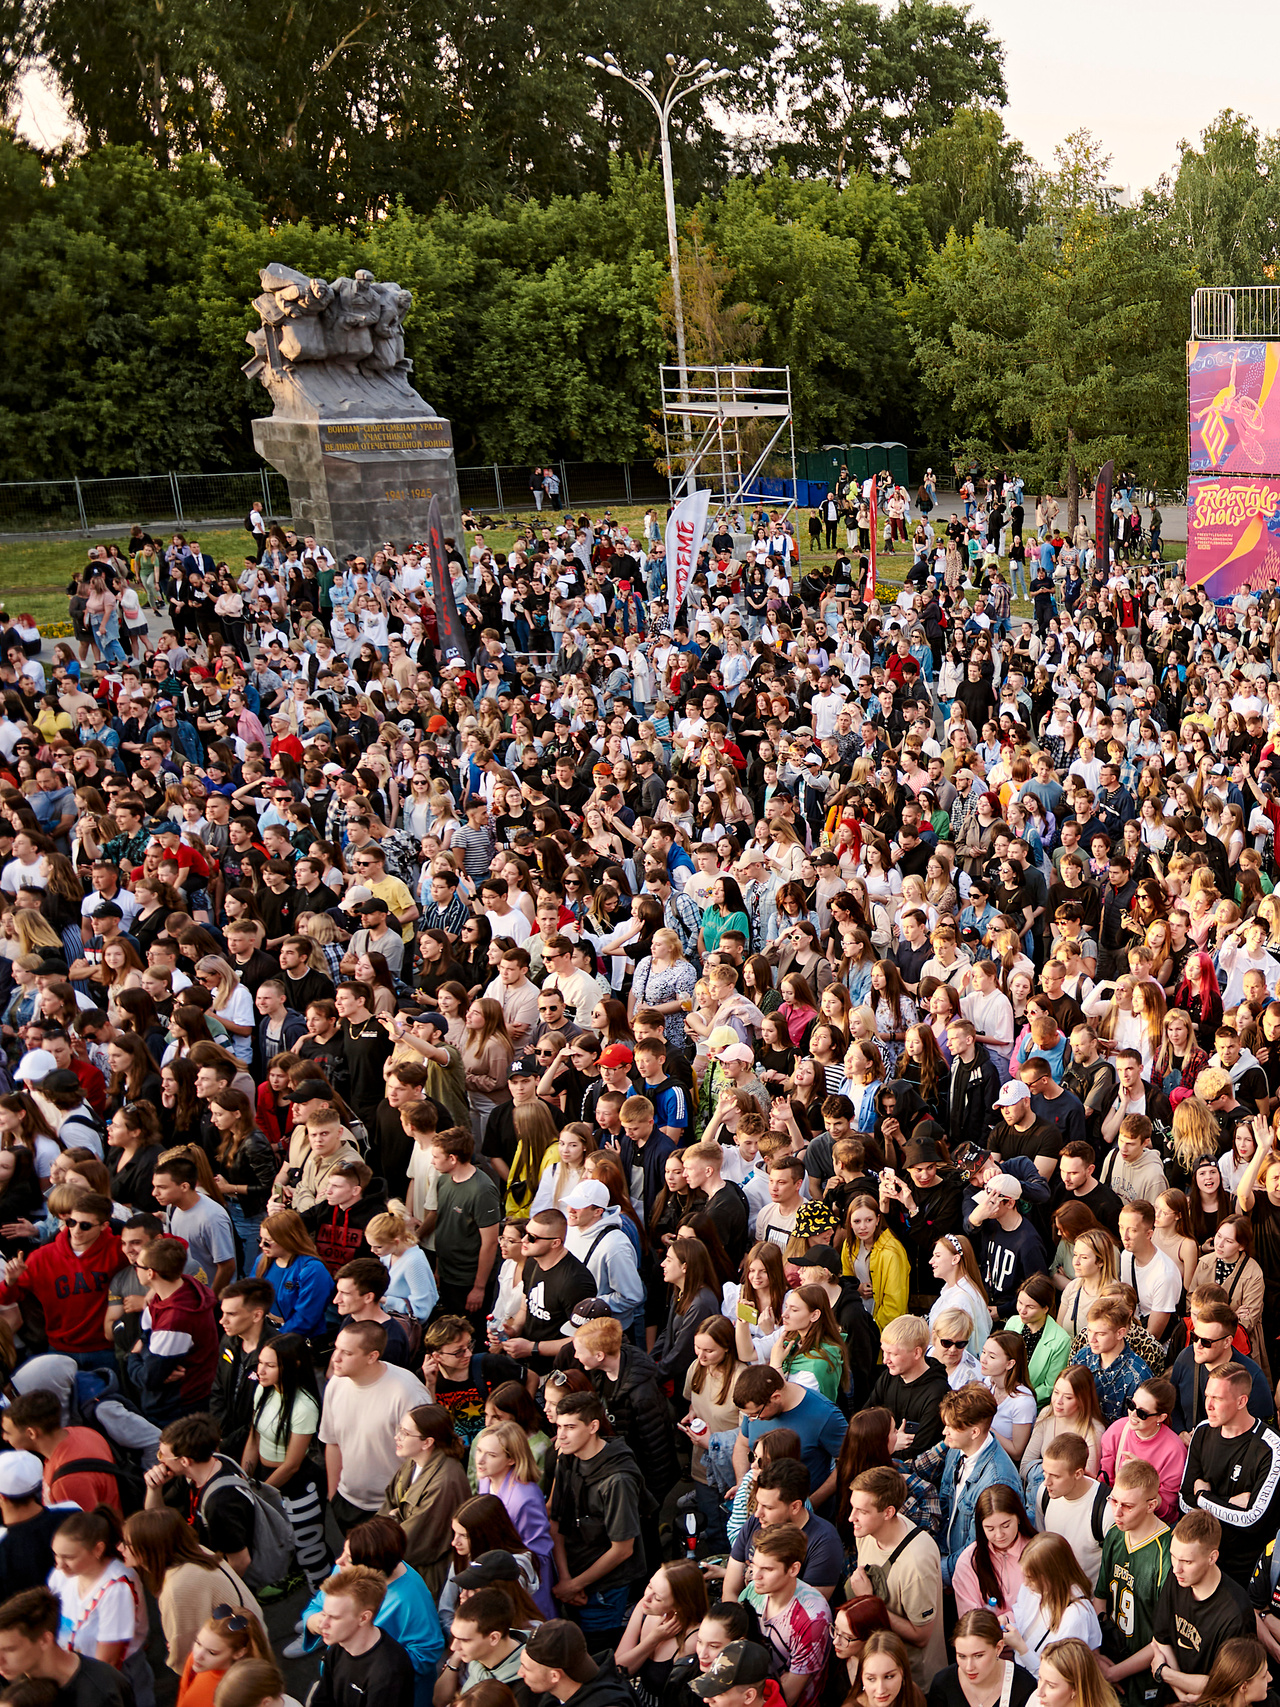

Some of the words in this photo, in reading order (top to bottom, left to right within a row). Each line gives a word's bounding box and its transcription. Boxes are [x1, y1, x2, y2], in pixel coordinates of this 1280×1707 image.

[363, 432, 413, 441] УЧАСТНИКАМ
[420, 423, 443, 431] УРАЛА
[325, 442, 359, 452] ВЕЛИКОЙ
[361, 440, 422, 450] ОТЕЧЕСТВЕННОЙ
[675, 519, 695, 617] TREME
[55, 1271, 109, 1299] GAP
[1109, 1579, 1134, 1637] 19
[1174, 1613, 1202, 1652] NIKE
